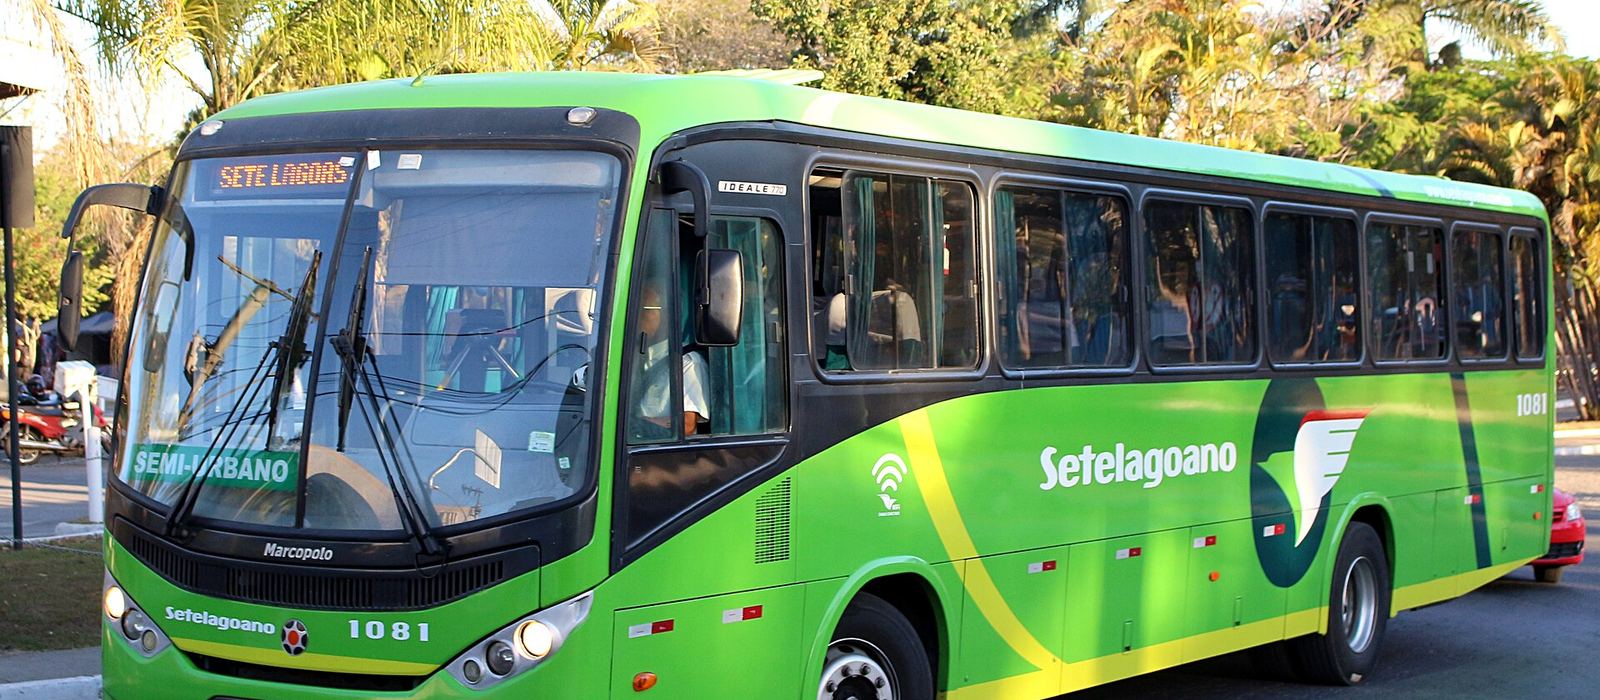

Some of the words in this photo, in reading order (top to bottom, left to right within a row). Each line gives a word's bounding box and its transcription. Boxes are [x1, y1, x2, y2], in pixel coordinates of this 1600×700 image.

[220, 164, 268, 188] SETE
[270, 161, 347, 186] LAGOAS
[723, 182, 769, 193] IDEALE
[771, 185, 784, 194] 770
[1516, 392, 1547, 417] 1081
[134, 450, 289, 482] SEMI-URBANO
[1039, 441, 1237, 491] Setelagoano
[263, 542, 333, 560] Marcopolo
[164, 606, 276, 635] Setelagoano
[348, 619, 429, 642] 1081
